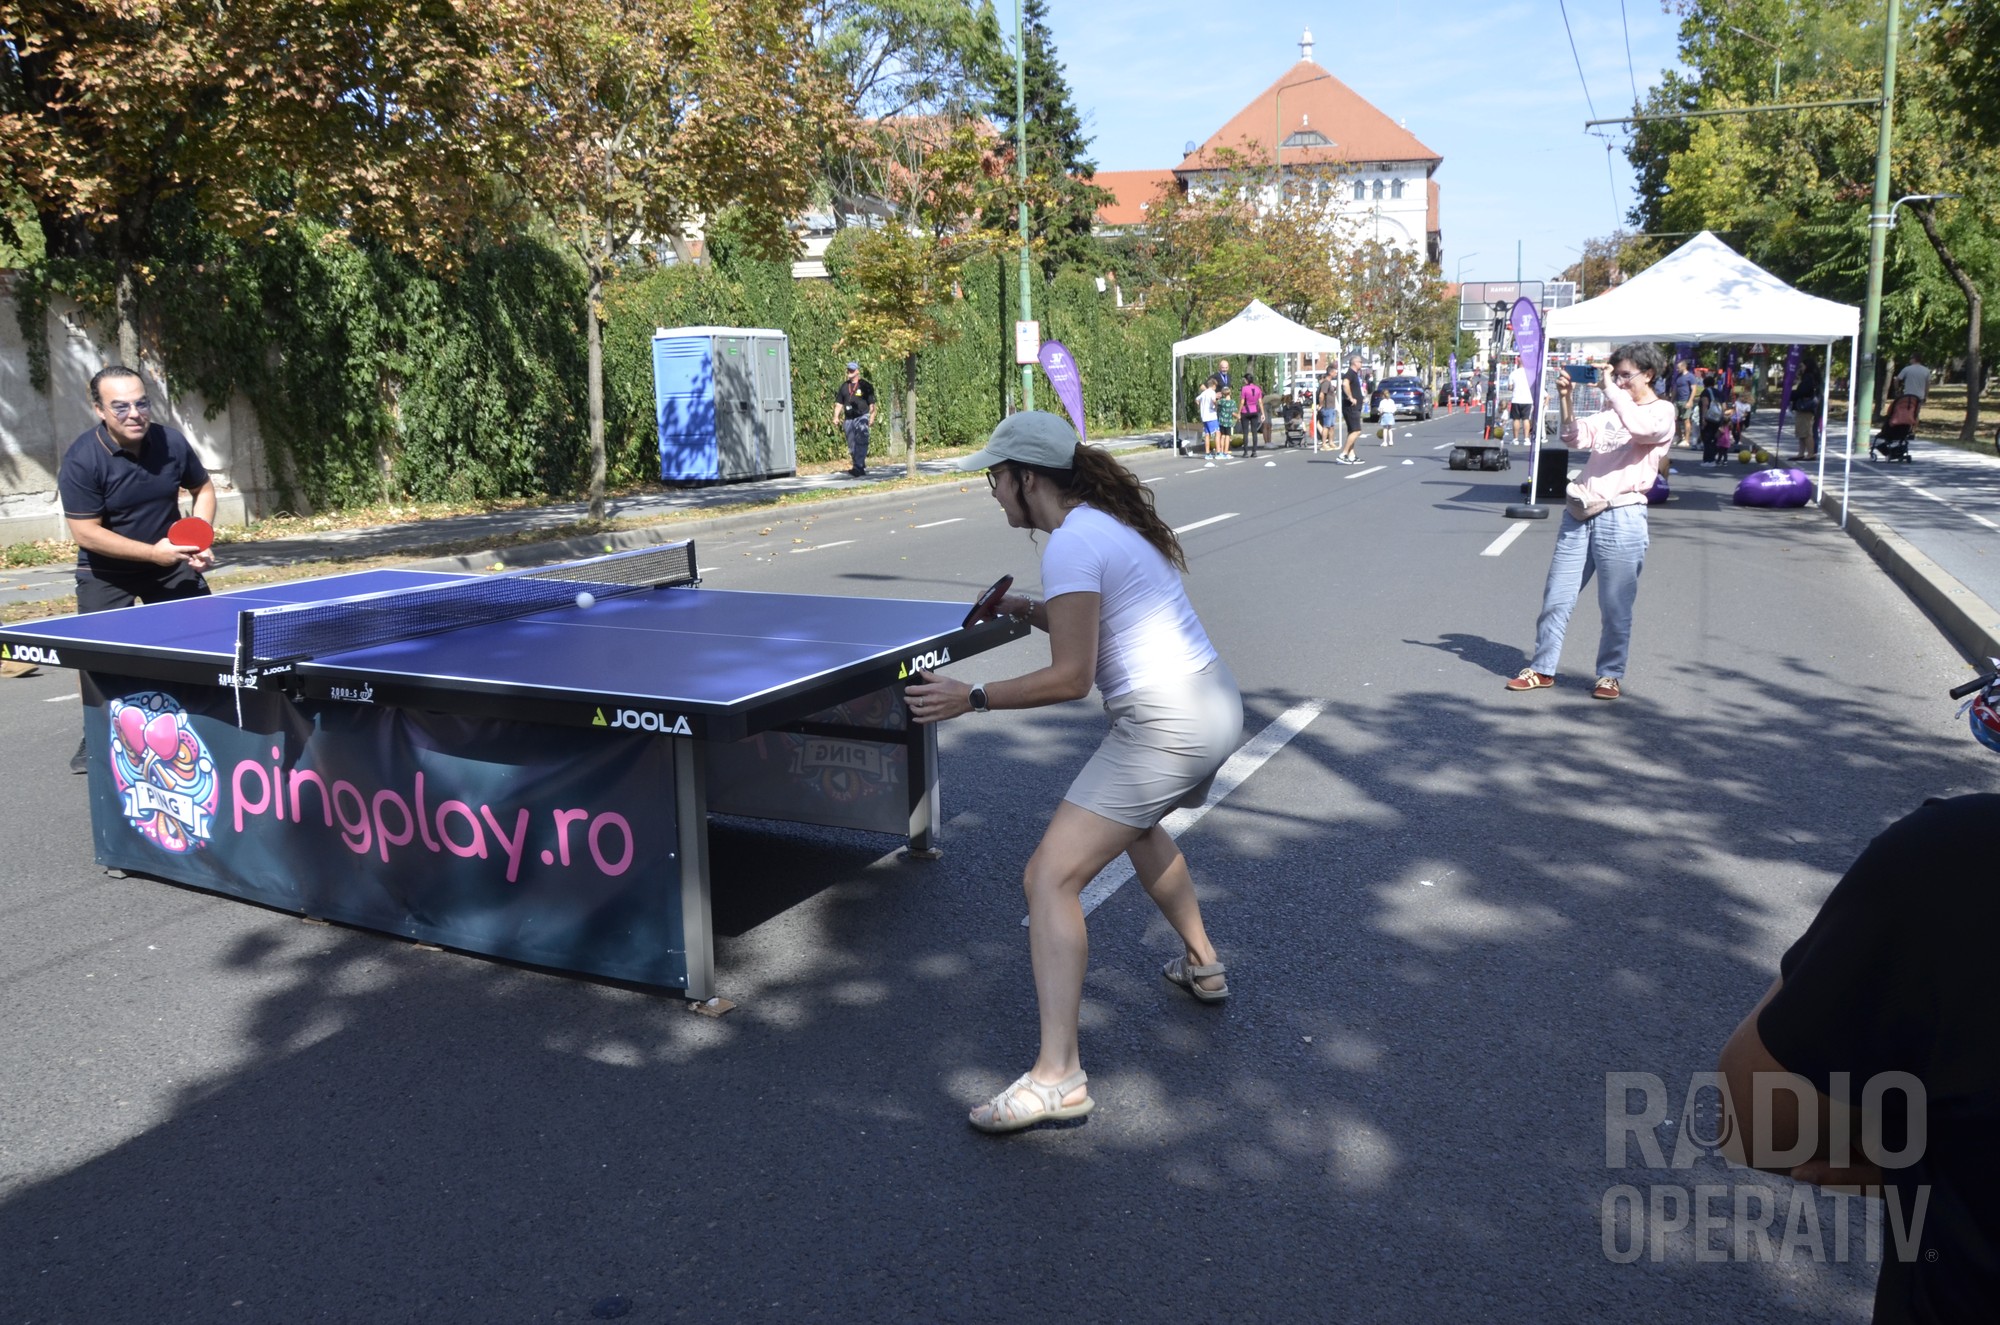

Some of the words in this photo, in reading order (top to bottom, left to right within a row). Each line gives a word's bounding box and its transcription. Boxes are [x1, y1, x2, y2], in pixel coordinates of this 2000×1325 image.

[12, 645, 61, 665] JOOLA
[908, 647, 951, 676] JOOLA
[268, 664, 292, 674] JOOLA
[331, 686, 358, 698] 2000-S
[610, 709, 693, 735] JOOLA
[146, 787, 180, 816] PING
[233, 746, 634, 882] pingplay.ro
